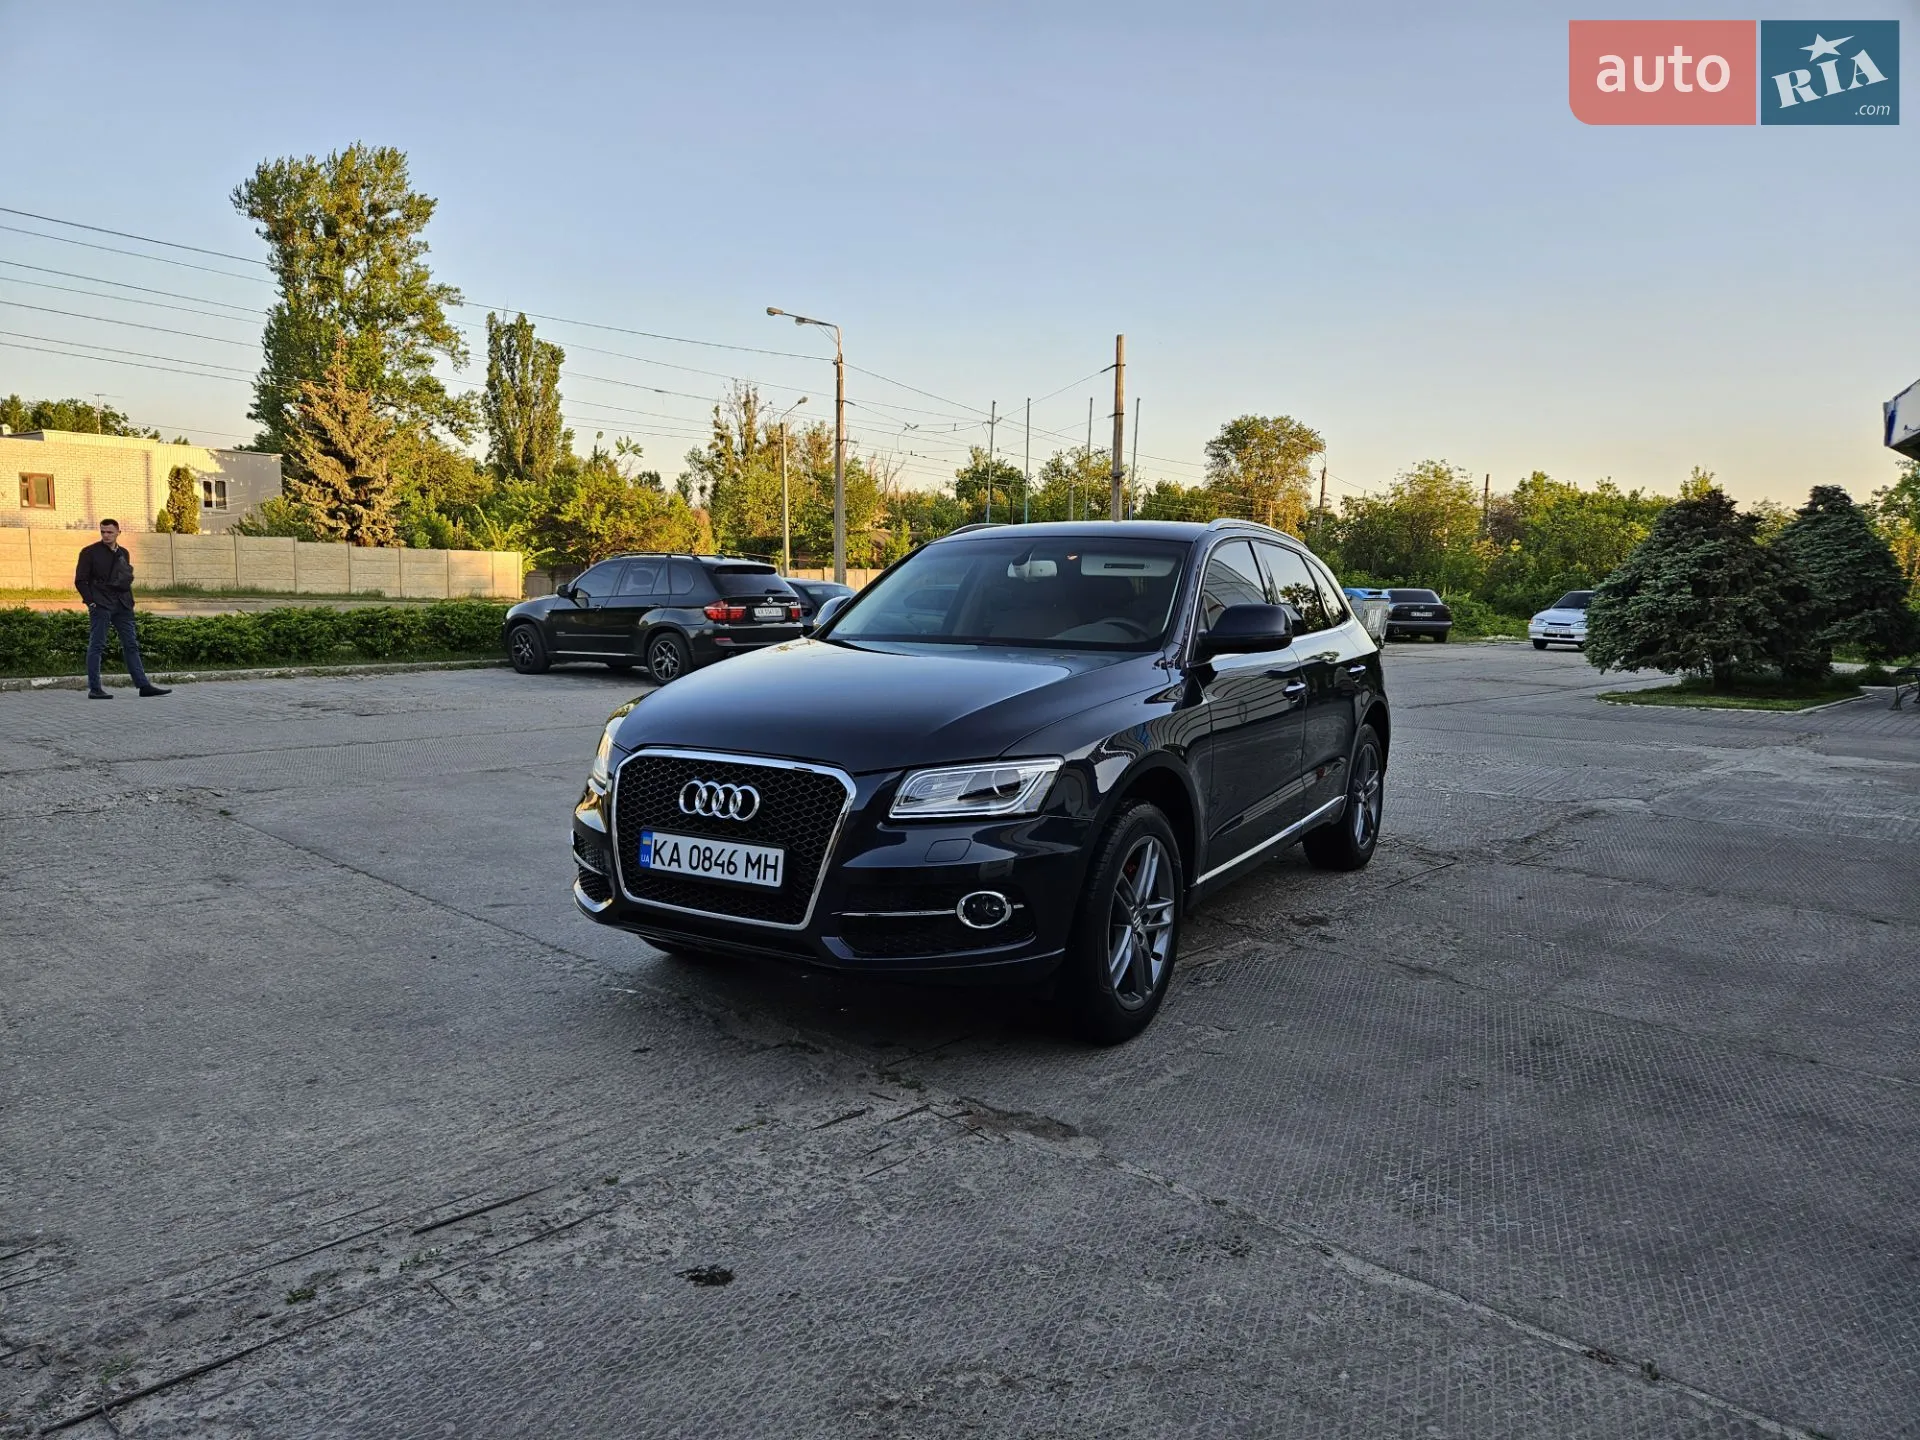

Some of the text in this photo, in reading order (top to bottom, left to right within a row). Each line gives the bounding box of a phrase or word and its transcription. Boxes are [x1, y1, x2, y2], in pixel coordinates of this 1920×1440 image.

[640, 853, 650, 863] UA
[652, 839, 779, 882] KA 0846 MH
